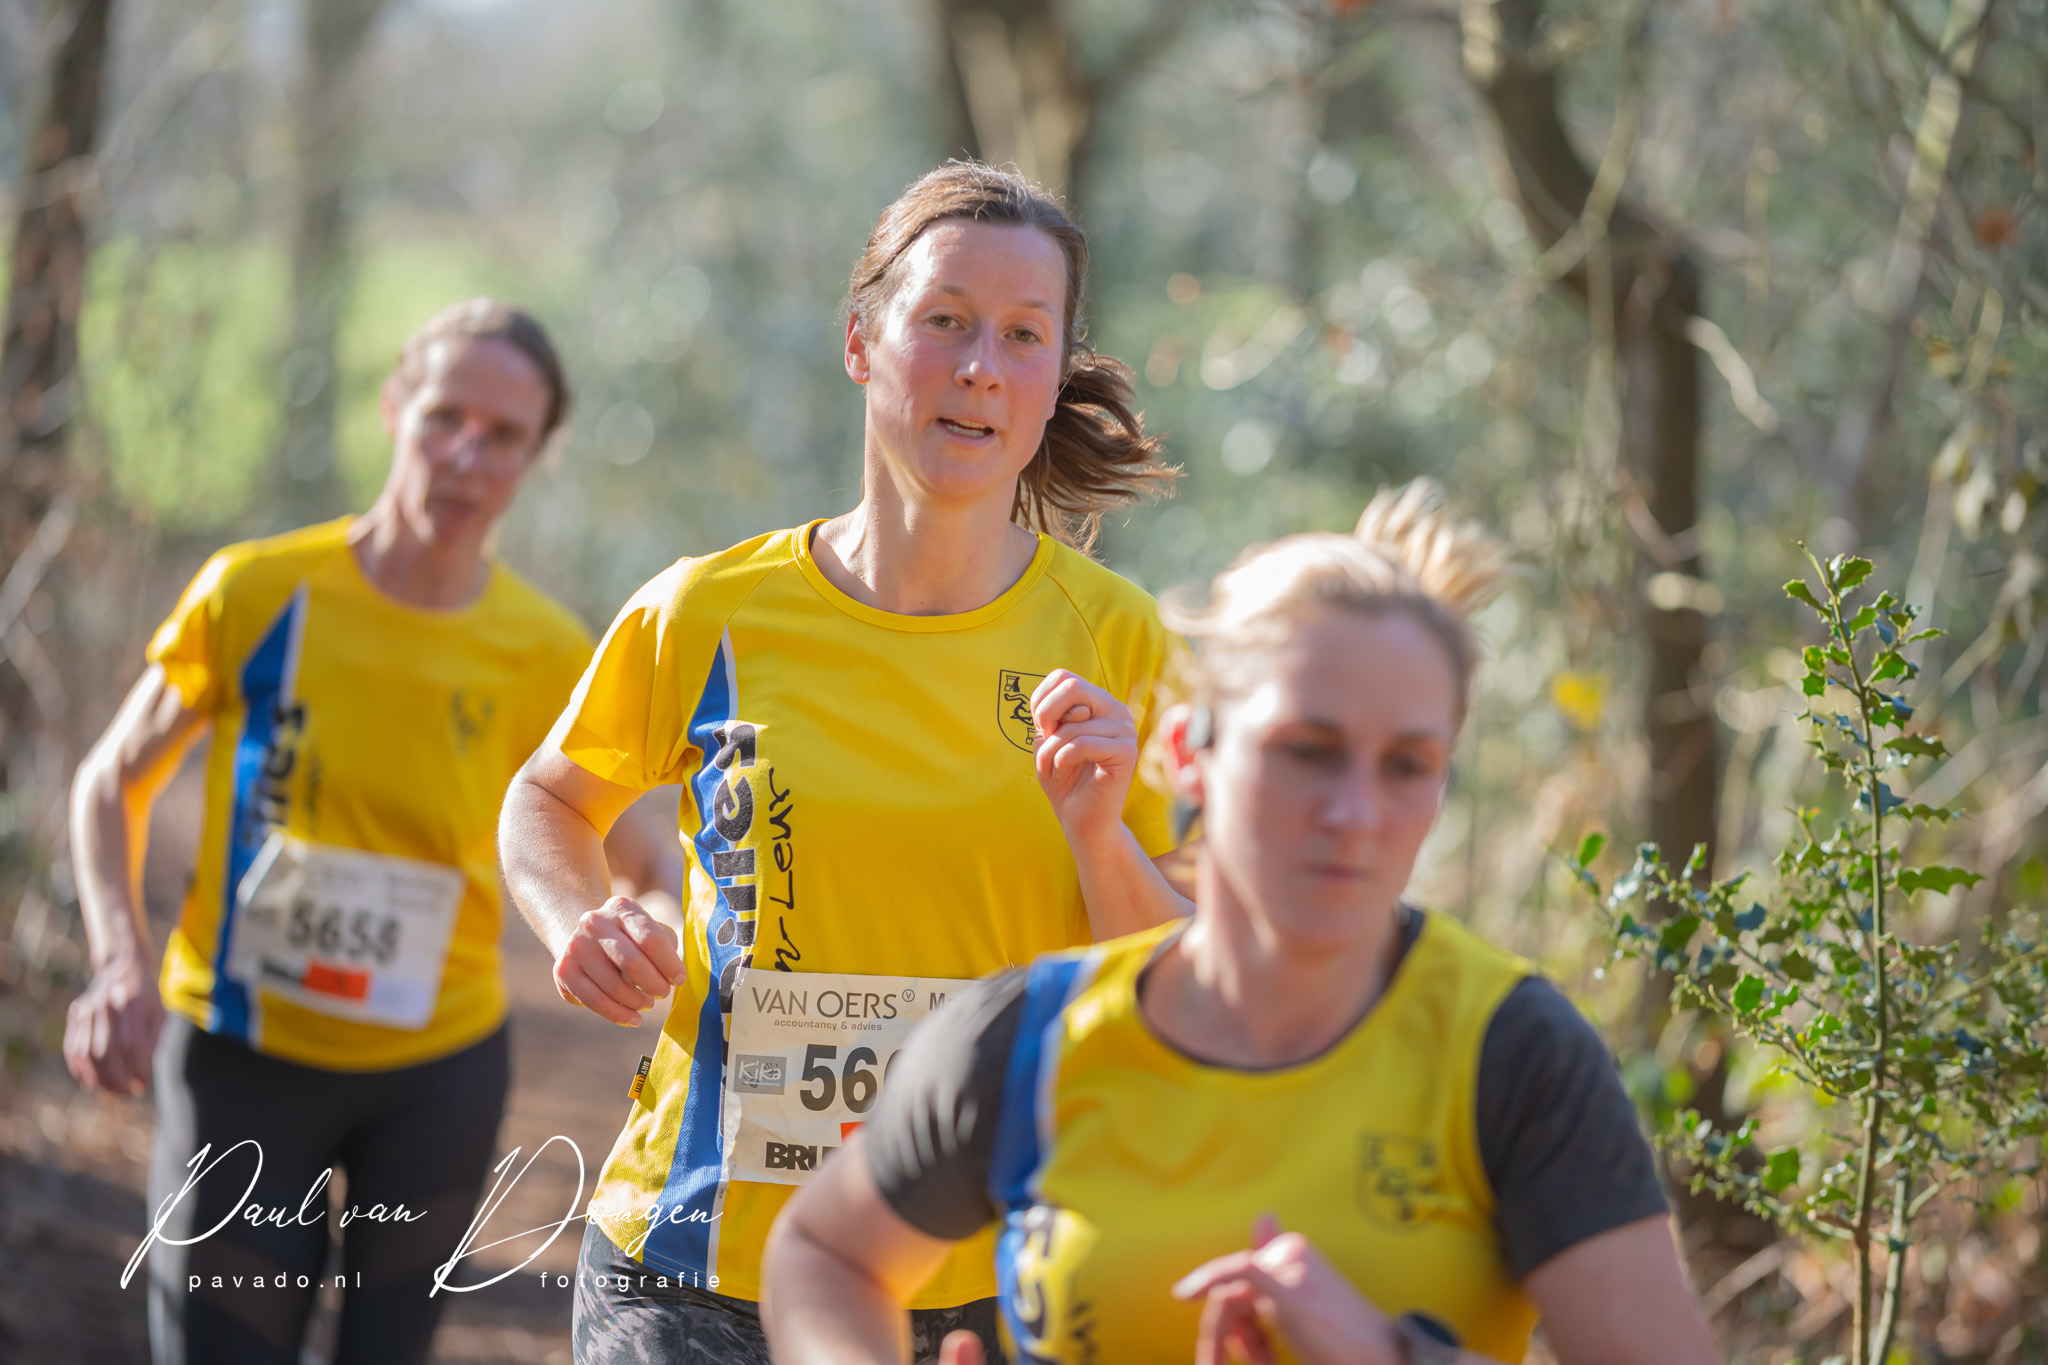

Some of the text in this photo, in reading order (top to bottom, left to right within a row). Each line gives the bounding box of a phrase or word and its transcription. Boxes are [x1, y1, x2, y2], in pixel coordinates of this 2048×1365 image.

[752, 987, 808, 1016] VAN
[817, 990, 897, 1019] OERS
[774, 1019, 882, 1031] accountancy & advies
[800, 1043, 903, 1114] 56
